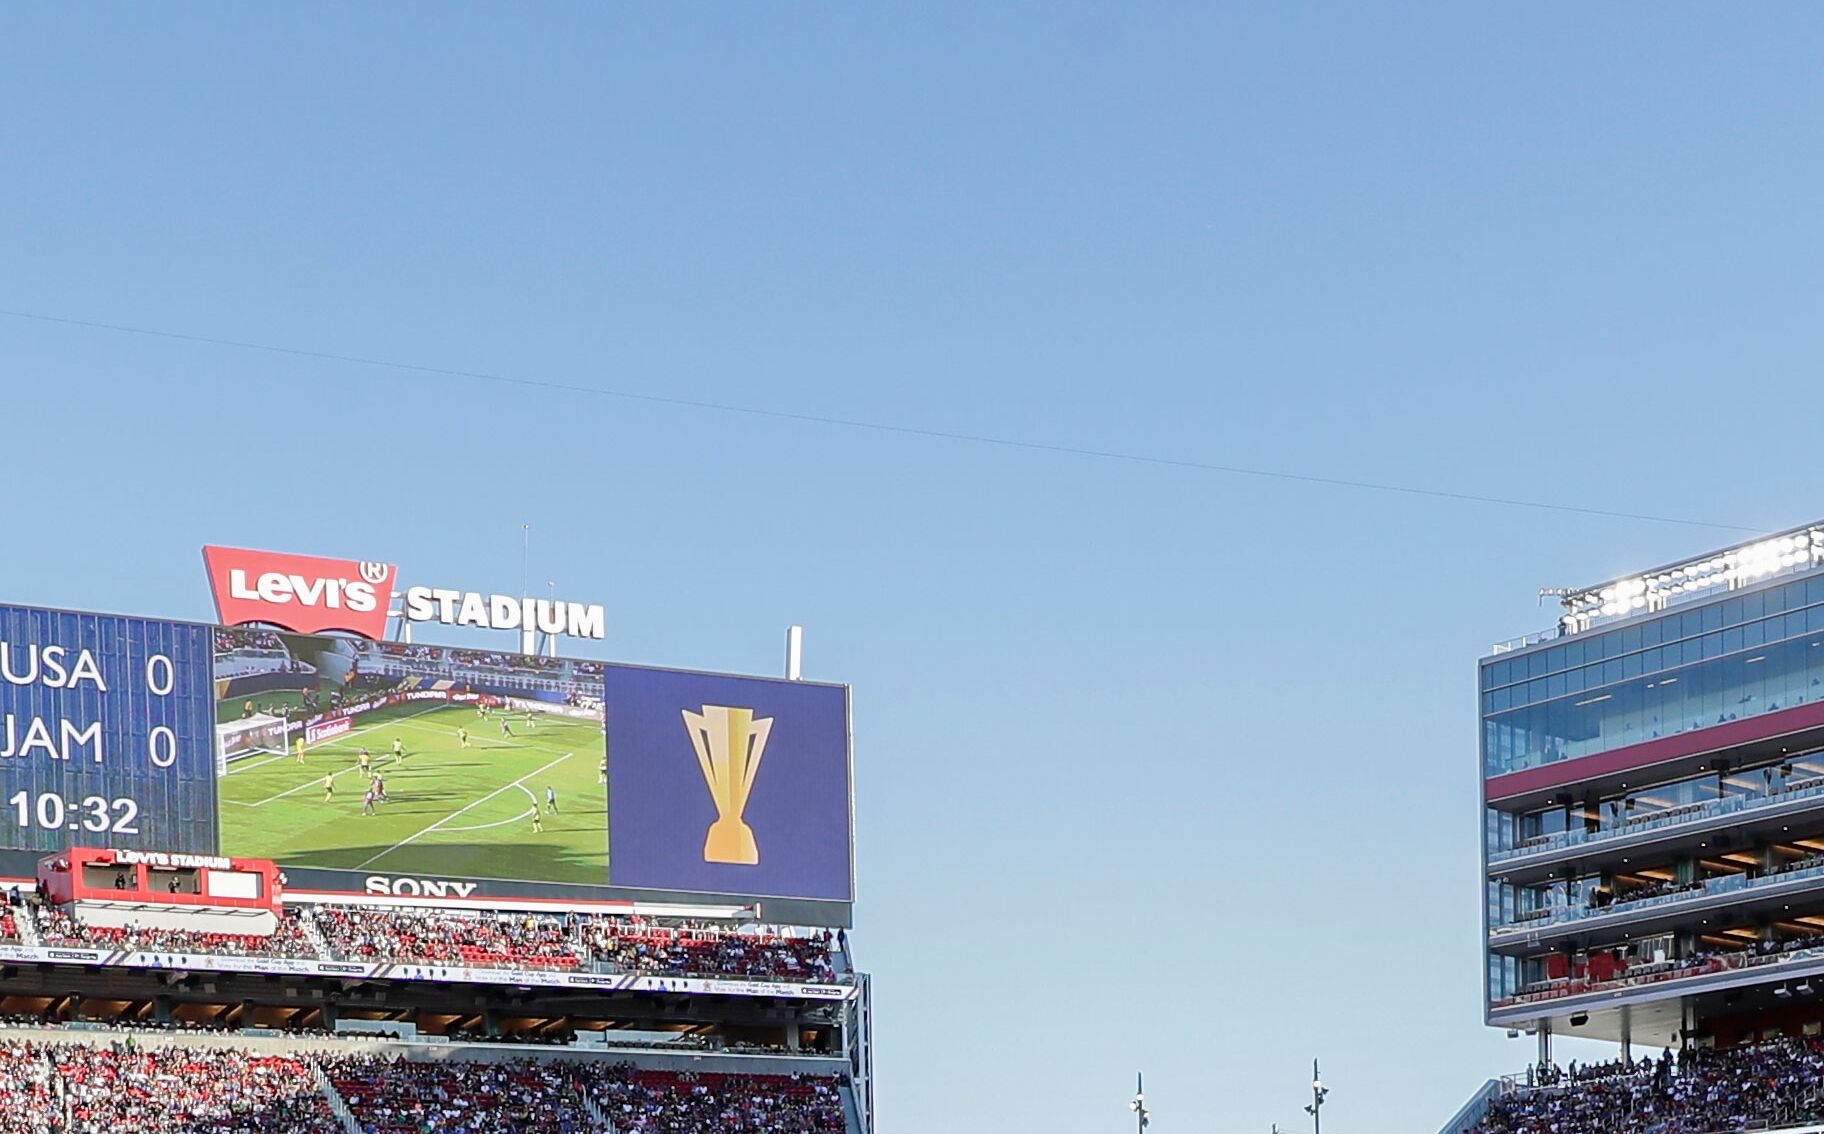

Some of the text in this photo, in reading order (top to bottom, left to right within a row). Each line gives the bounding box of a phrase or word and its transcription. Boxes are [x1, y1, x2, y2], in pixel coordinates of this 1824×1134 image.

[407, 586, 605, 639] STADIUM
[0, 640, 175, 697] USA 0
[0, 713, 177, 768] JAM 0
[9, 789, 140, 836] 10:32
[170, 854, 231, 869] STADIUM
[365, 875, 478, 898] SONY
